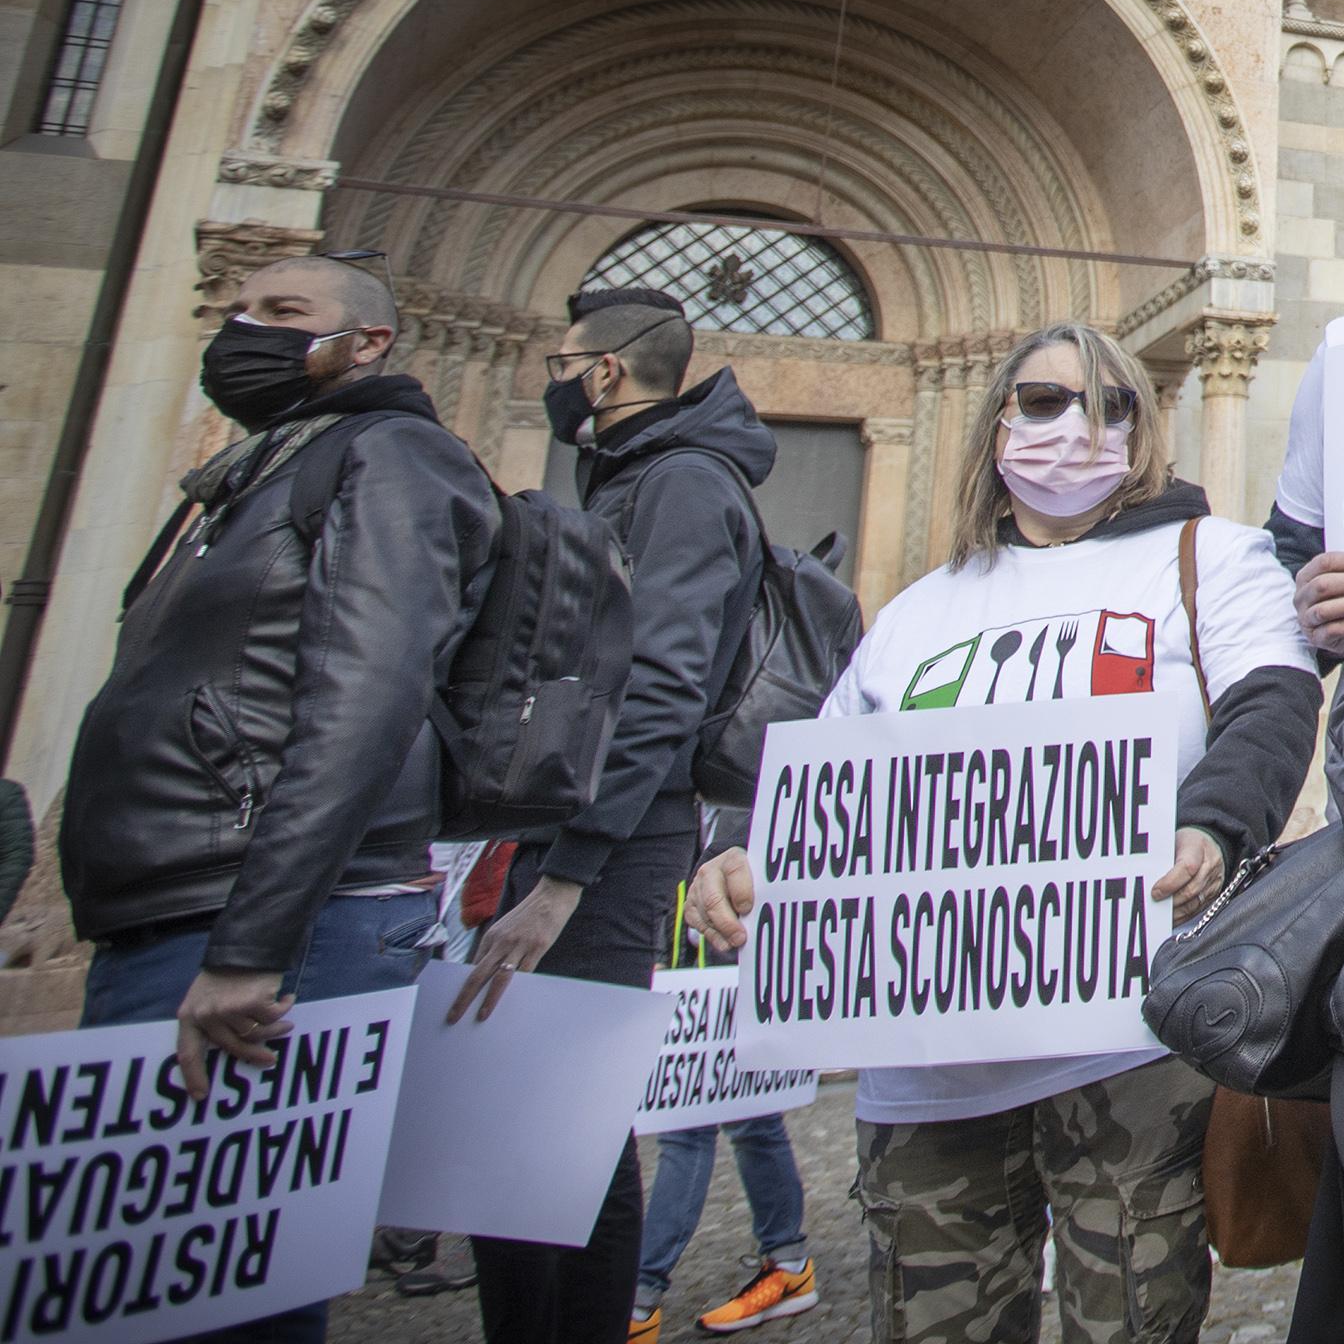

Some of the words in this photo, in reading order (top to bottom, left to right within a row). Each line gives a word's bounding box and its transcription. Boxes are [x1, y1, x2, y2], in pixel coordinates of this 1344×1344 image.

[765, 759, 873, 883] CASSA
[883, 737, 1152, 874] INTEGRAZIONE
[754, 896, 877, 1024] QUESTA
[887, 876, 1151, 1017] SCONOSCIUTA
[355, 1019, 391, 1095] E
[664, 987, 711, 1044] SSA
[713, 987, 738, 1042] IN
[0, 1026, 350, 1150] INESISTEN
[637, 1051, 707, 1112] UESTA
[2, 1207, 281, 1342] RISTORI
